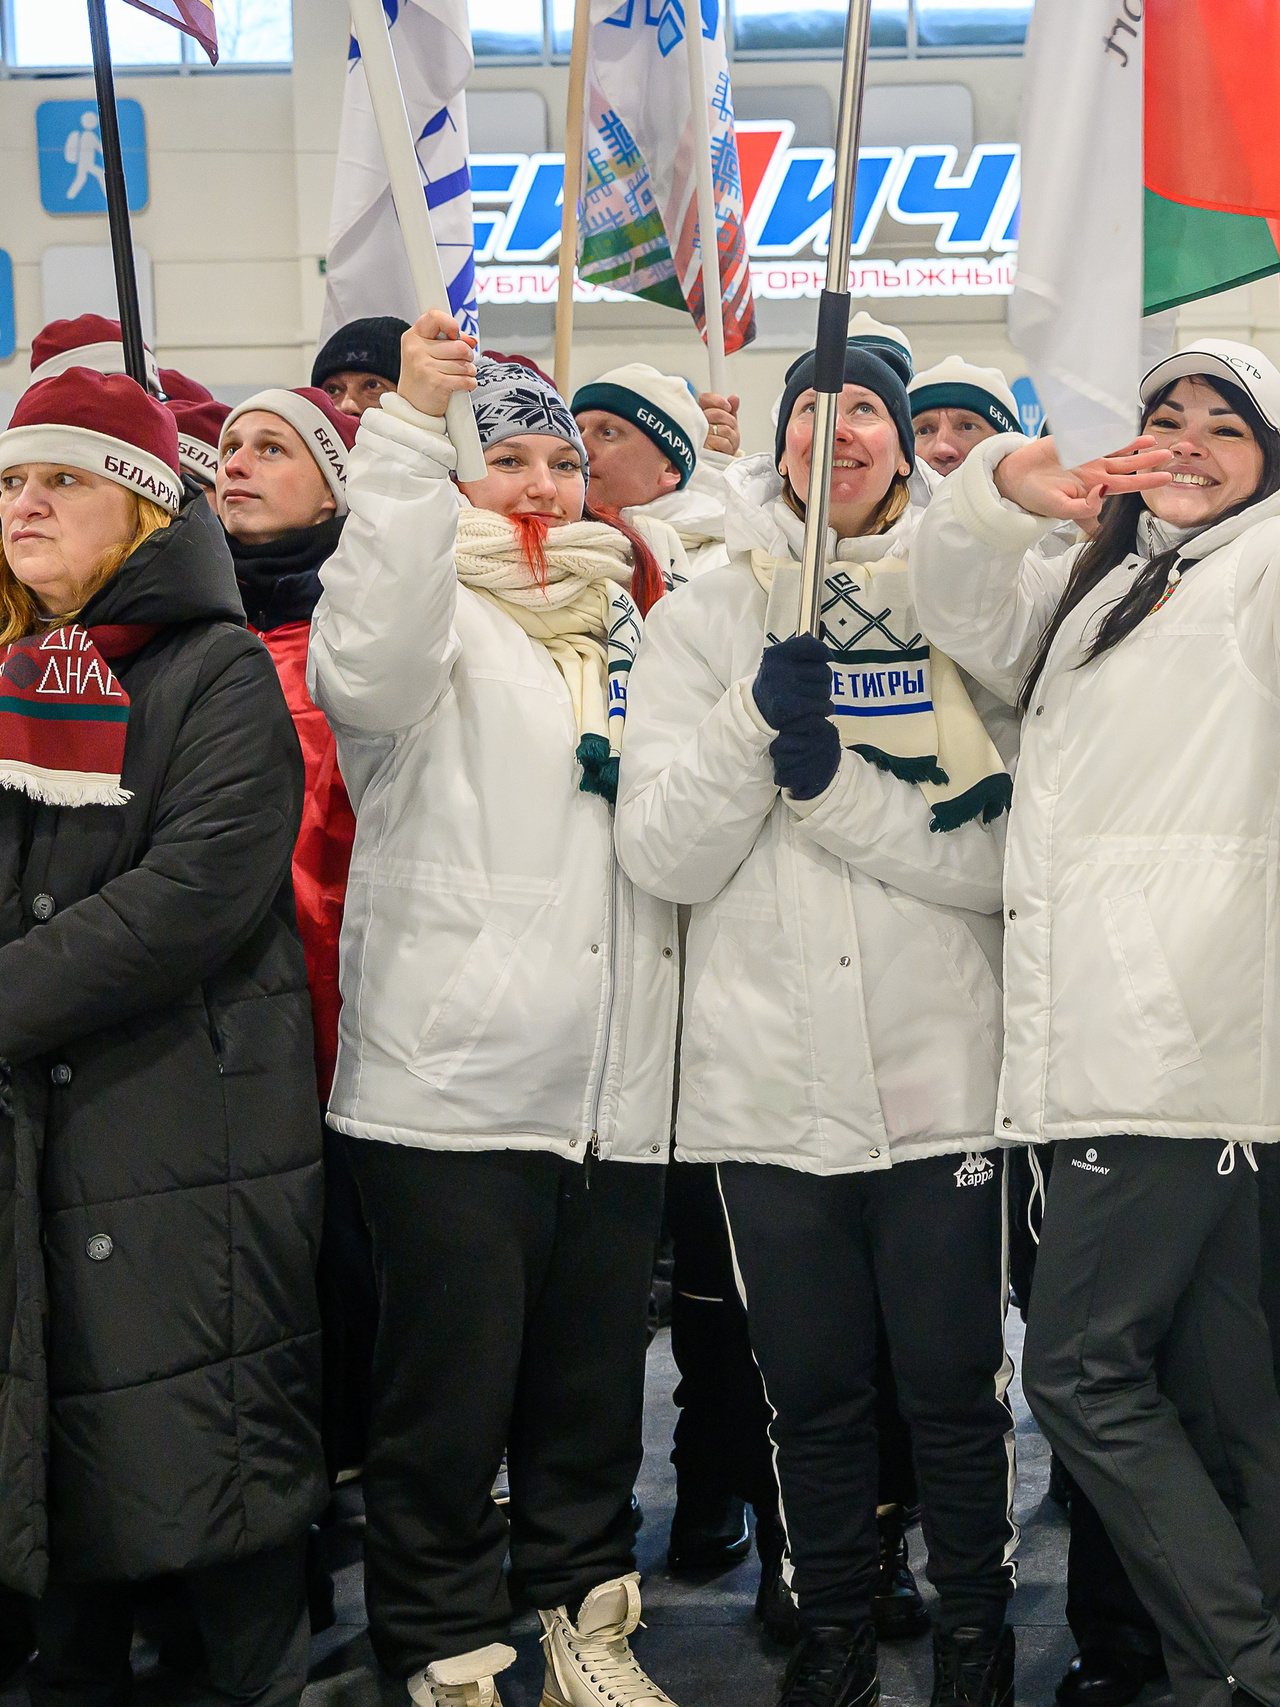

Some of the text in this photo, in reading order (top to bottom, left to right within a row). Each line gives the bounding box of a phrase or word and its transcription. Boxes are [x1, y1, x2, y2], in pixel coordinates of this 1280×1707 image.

[848, 668, 924, 698] ТИГРЫ
[1071, 1158, 1110, 1176] NORDWAY
[956, 1168, 994, 1188] Kappa
